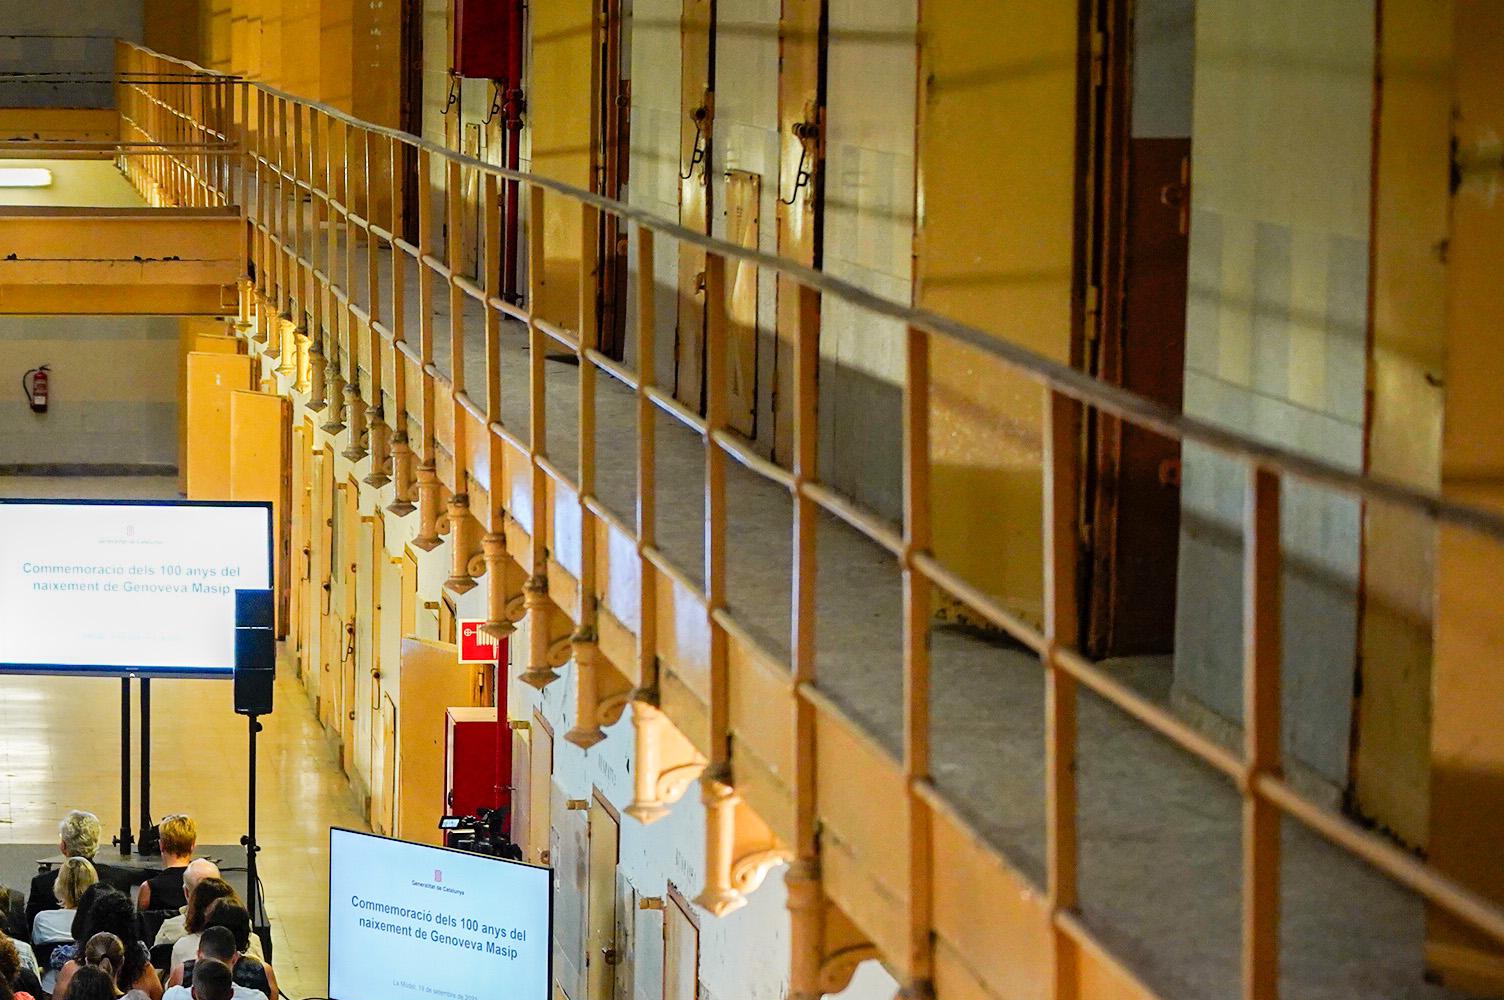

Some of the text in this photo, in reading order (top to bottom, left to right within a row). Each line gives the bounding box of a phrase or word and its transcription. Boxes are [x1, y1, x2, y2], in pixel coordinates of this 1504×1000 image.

[128, 564, 155, 576] dels
[161, 565, 182, 576] 100
[186, 567, 216, 579] anys
[221, 566, 240, 577] del
[33, 581, 230, 596] naixement de Genoveva Masip
[351, 895, 526, 942] Commemoració dels 100 anys del
[359, 917, 518, 961] naixement de Genoveva Masip
